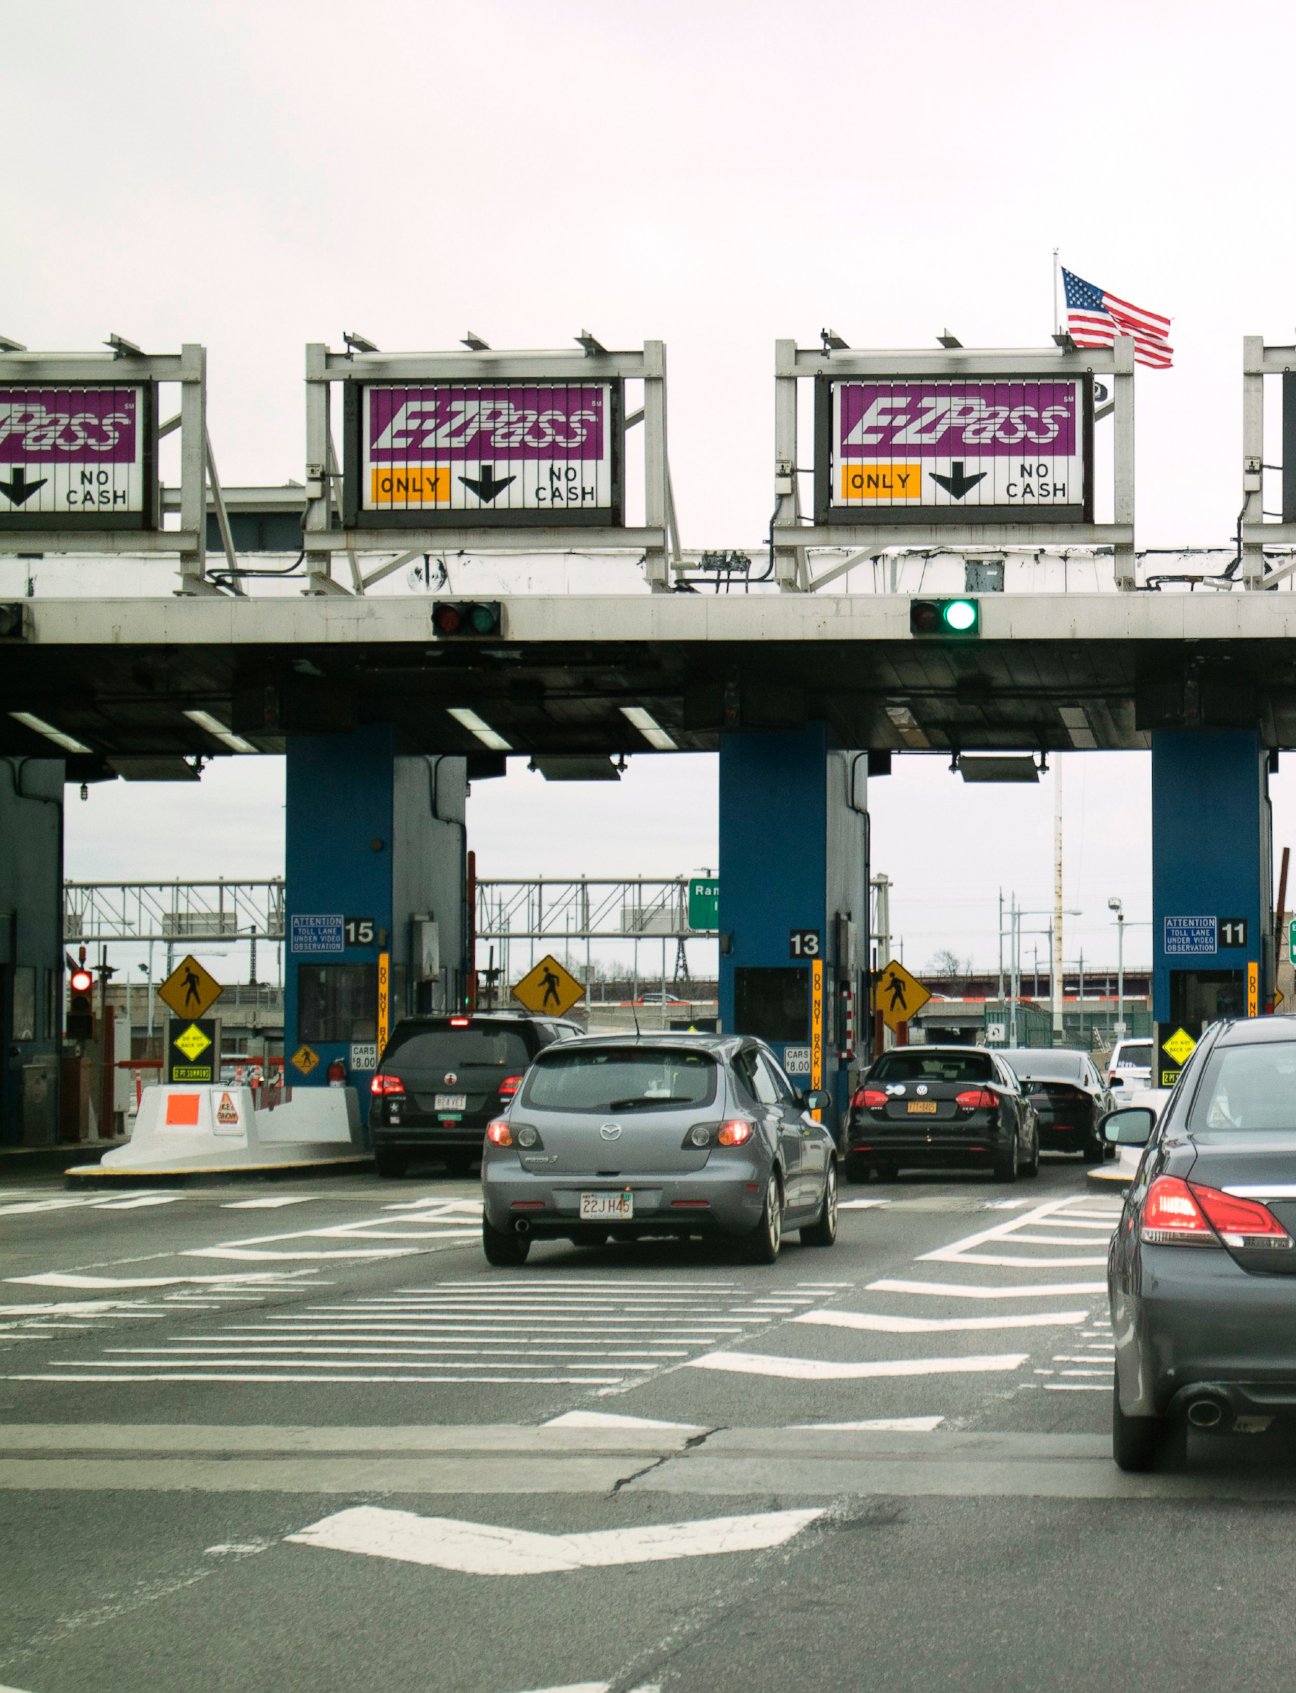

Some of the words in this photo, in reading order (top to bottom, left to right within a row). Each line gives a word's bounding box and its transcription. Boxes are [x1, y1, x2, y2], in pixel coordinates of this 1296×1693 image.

[0, 403, 131, 451] Pass
[371, 400, 599, 449] E-ZPass
[842, 396, 1070, 444] E-ZPass
[81, 470, 109, 486] NO
[550, 466, 577, 482] NO
[1020, 463, 1049, 478] NO
[381, 477, 440, 493] ONLY
[852, 473, 910, 489] ONLY
[66, 490, 126, 505] CASH
[535, 486, 594, 501] CASH
[1006, 483, 1066, 498] CASH
[293, 917, 342, 926] ATTENTION
[1167, 919, 1215, 927] ATTENTION
[298, 927, 316, 935] TOLL
[318, 927, 337, 935] LANE
[345, 922, 374, 943] 15
[1171, 929, 1187, 937] TOLL
[1191, 929, 1210, 937] LANE
[1222, 923, 1244, 944] 11
[791, 934, 819, 955] 13
[353, 1047, 375, 1055] CARS
[787, 1050, 808, 1059] CARS
[786, 1060, 810, 1072] $8.00
